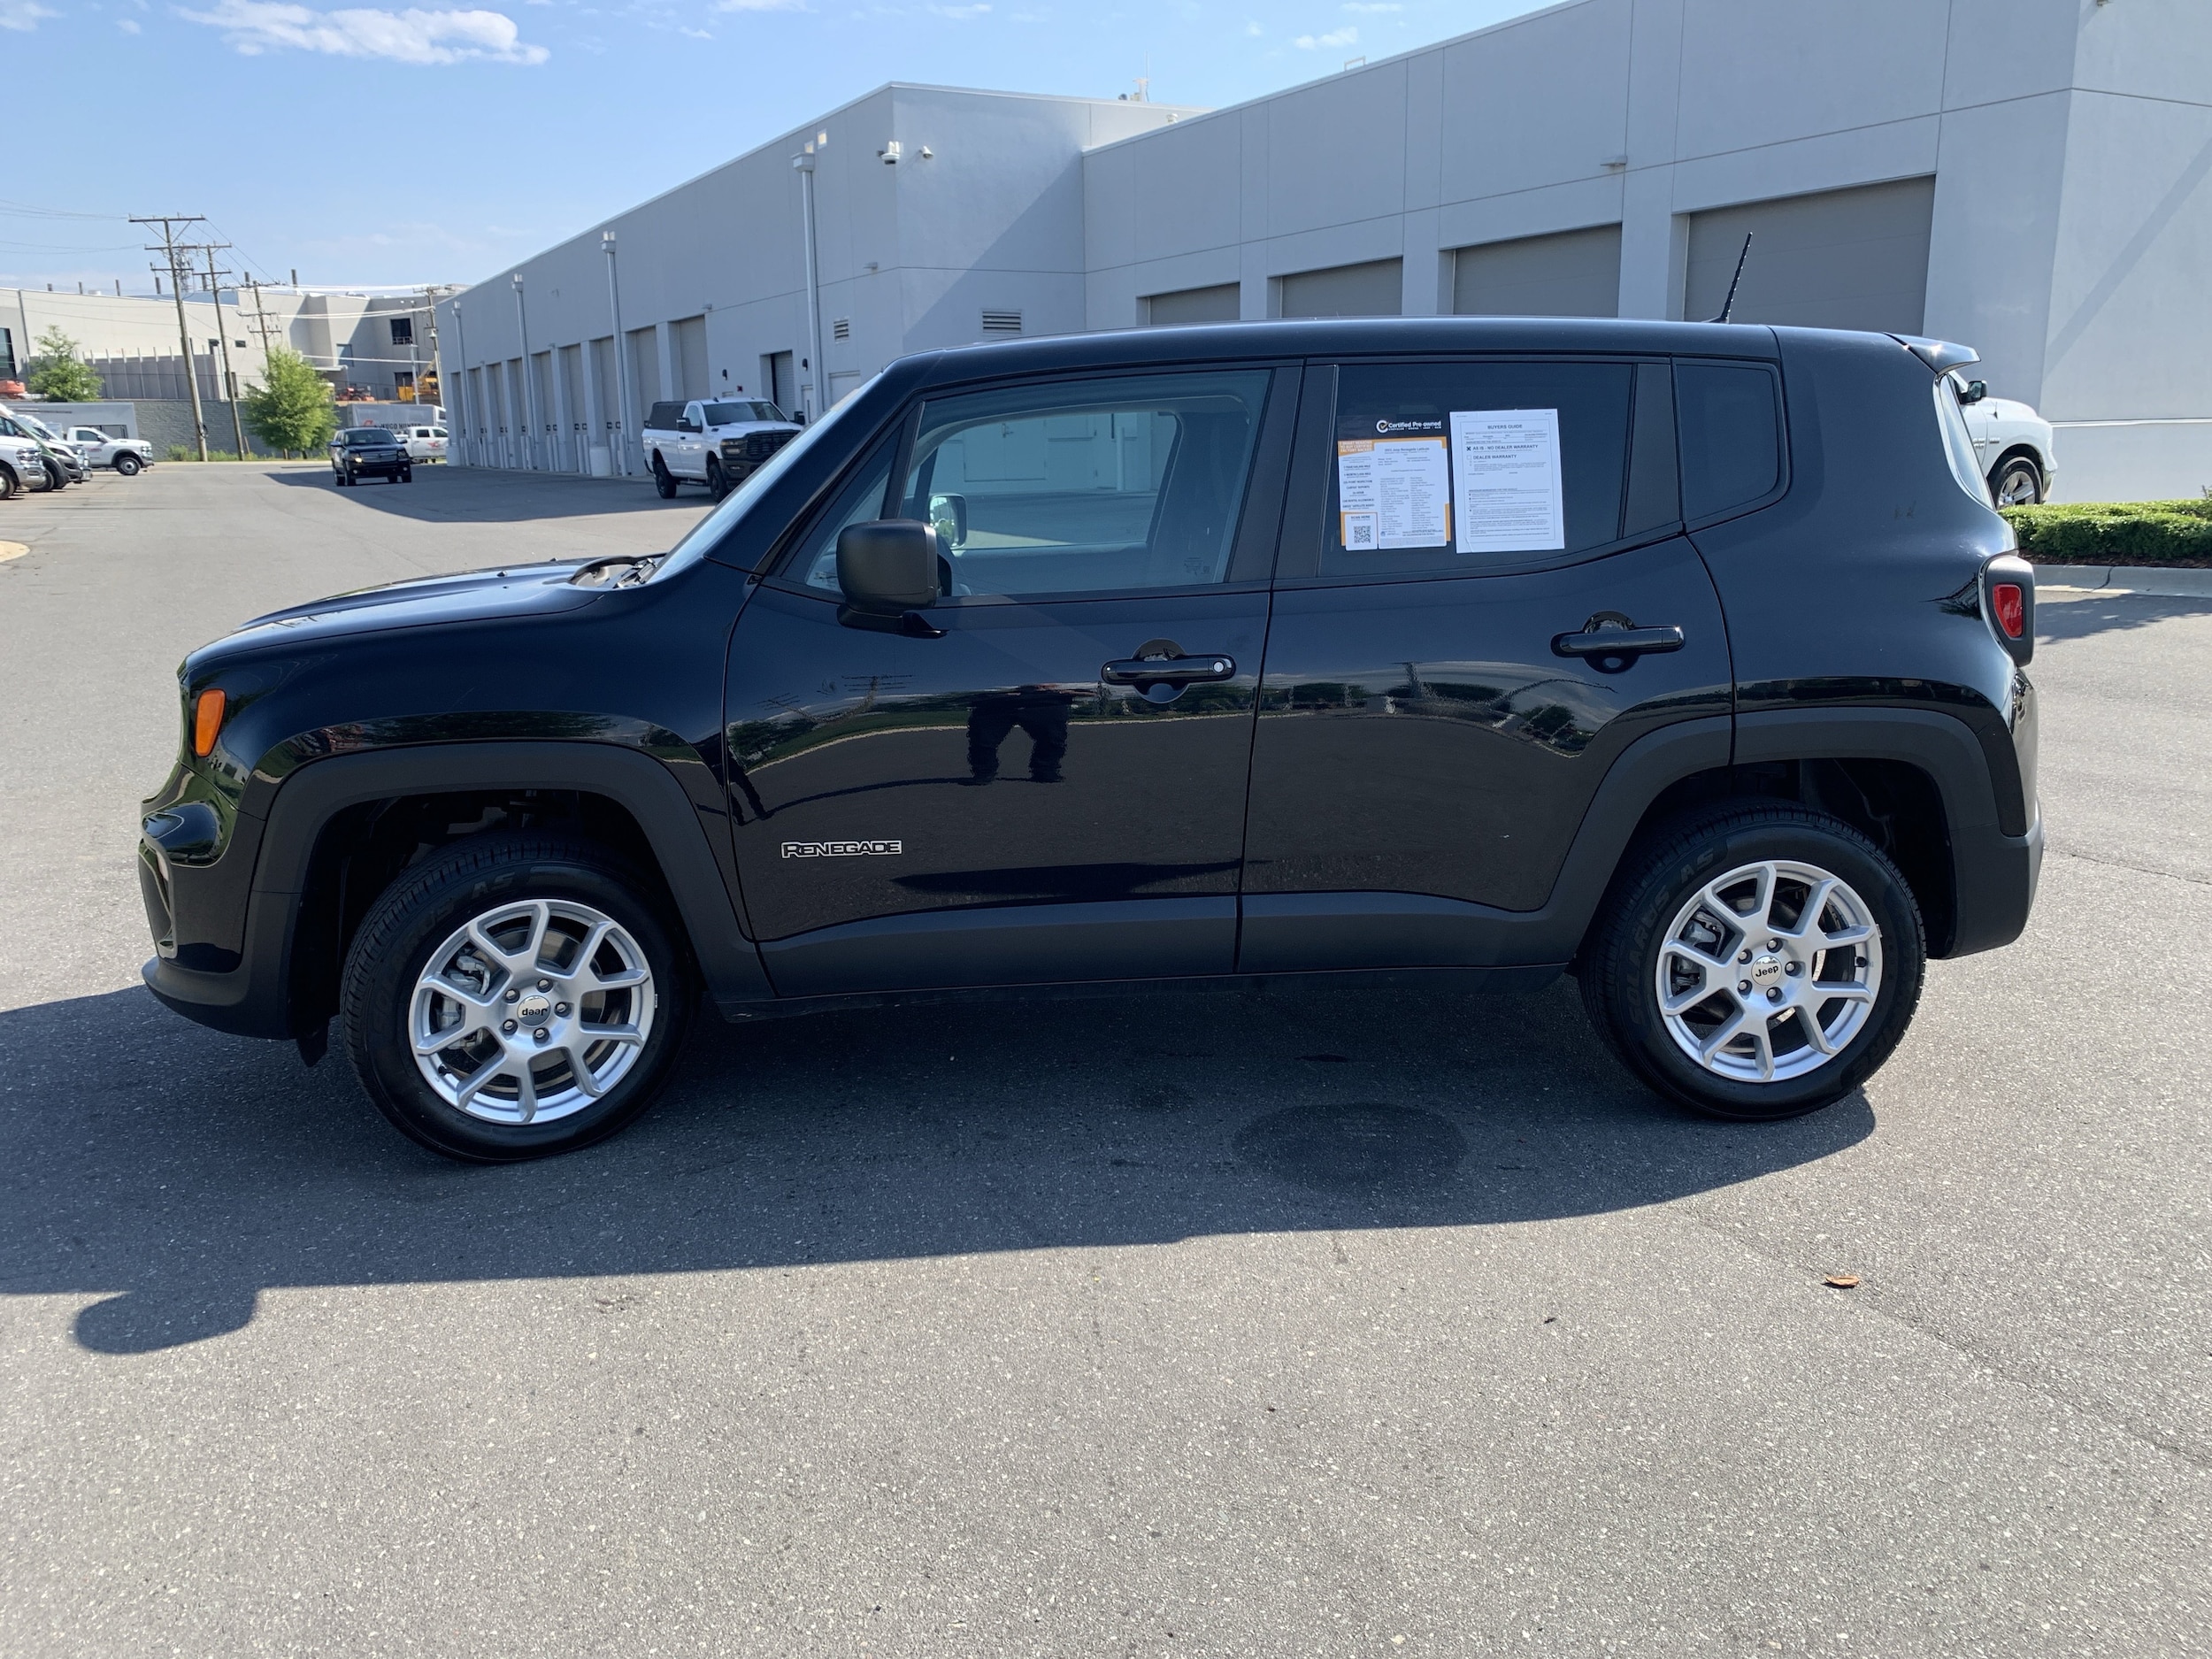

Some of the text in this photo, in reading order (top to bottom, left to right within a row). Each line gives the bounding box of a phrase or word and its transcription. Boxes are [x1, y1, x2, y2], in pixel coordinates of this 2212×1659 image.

[780, 840, 902, 859] RENEGADE
[1679, 849, 1715, 883] AS
[471, 871, 515, 899] AS
[1755, 965, 1779, 978] Jeep
[521, 1007, 549, 1017] Jeep
